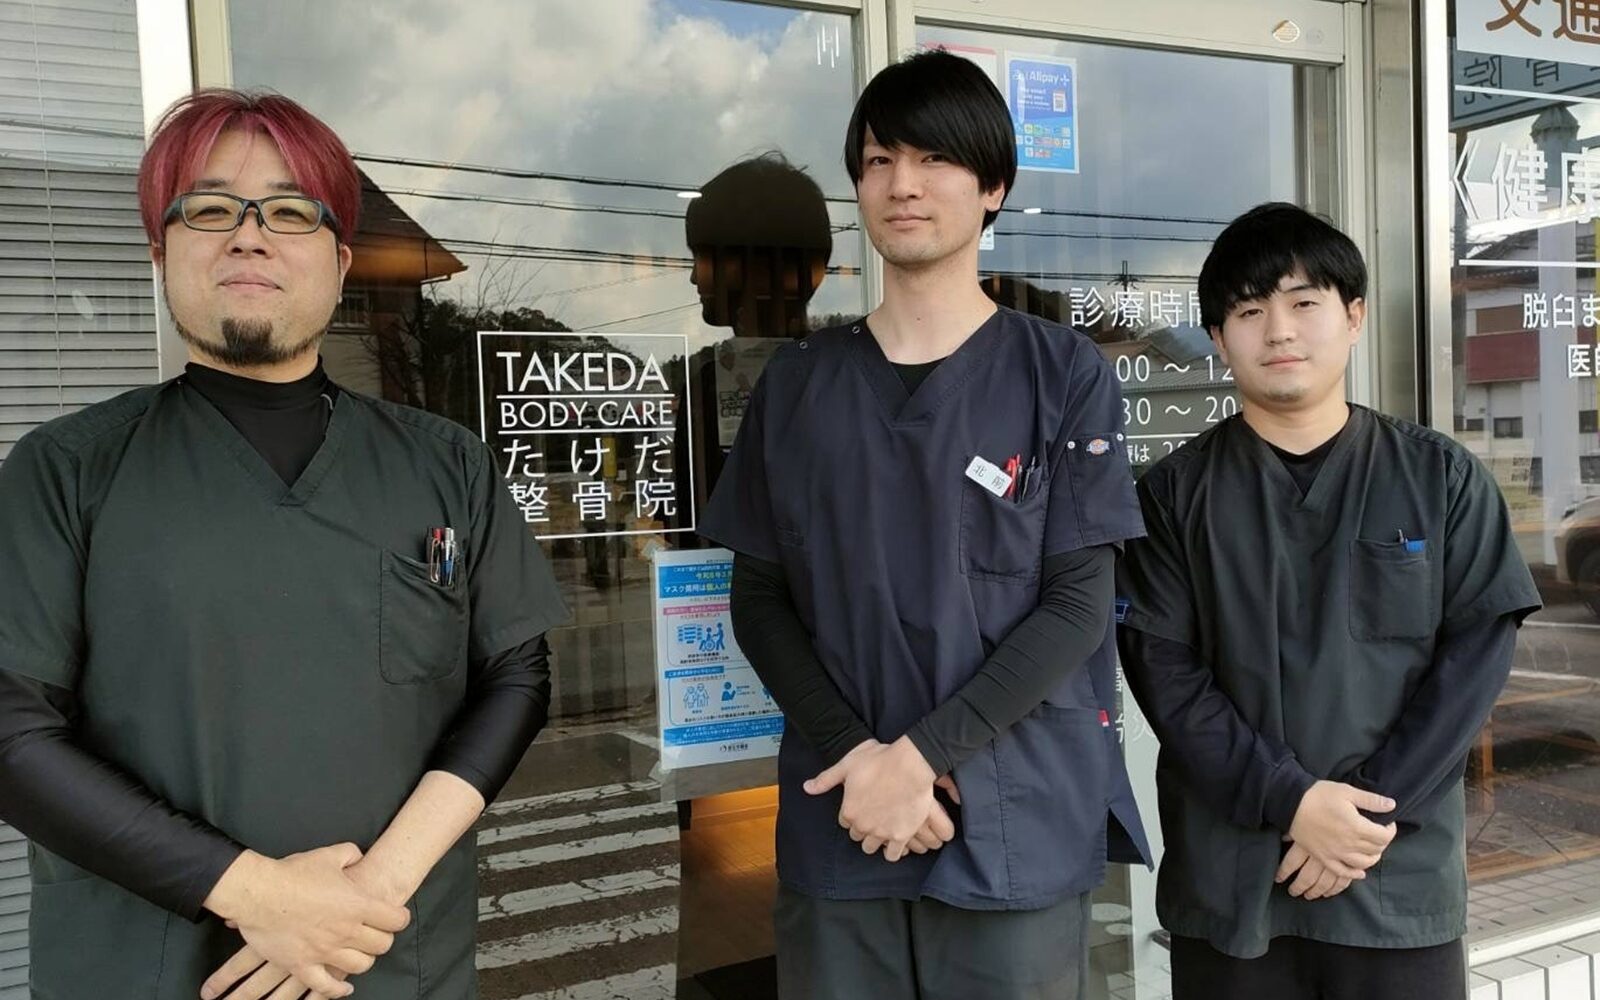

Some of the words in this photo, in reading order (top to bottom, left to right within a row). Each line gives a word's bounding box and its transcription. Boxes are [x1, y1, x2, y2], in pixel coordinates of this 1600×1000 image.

[496, 351, 669, 392] TAKEDA
[1567, 344, 1600, 378] 医
[501, 401, 588, 428] BODY
[598, 400, 673, 427] CARE
[503, 436, 674, 478] たけだ
[508, 478, 676, 523] 整骨院
